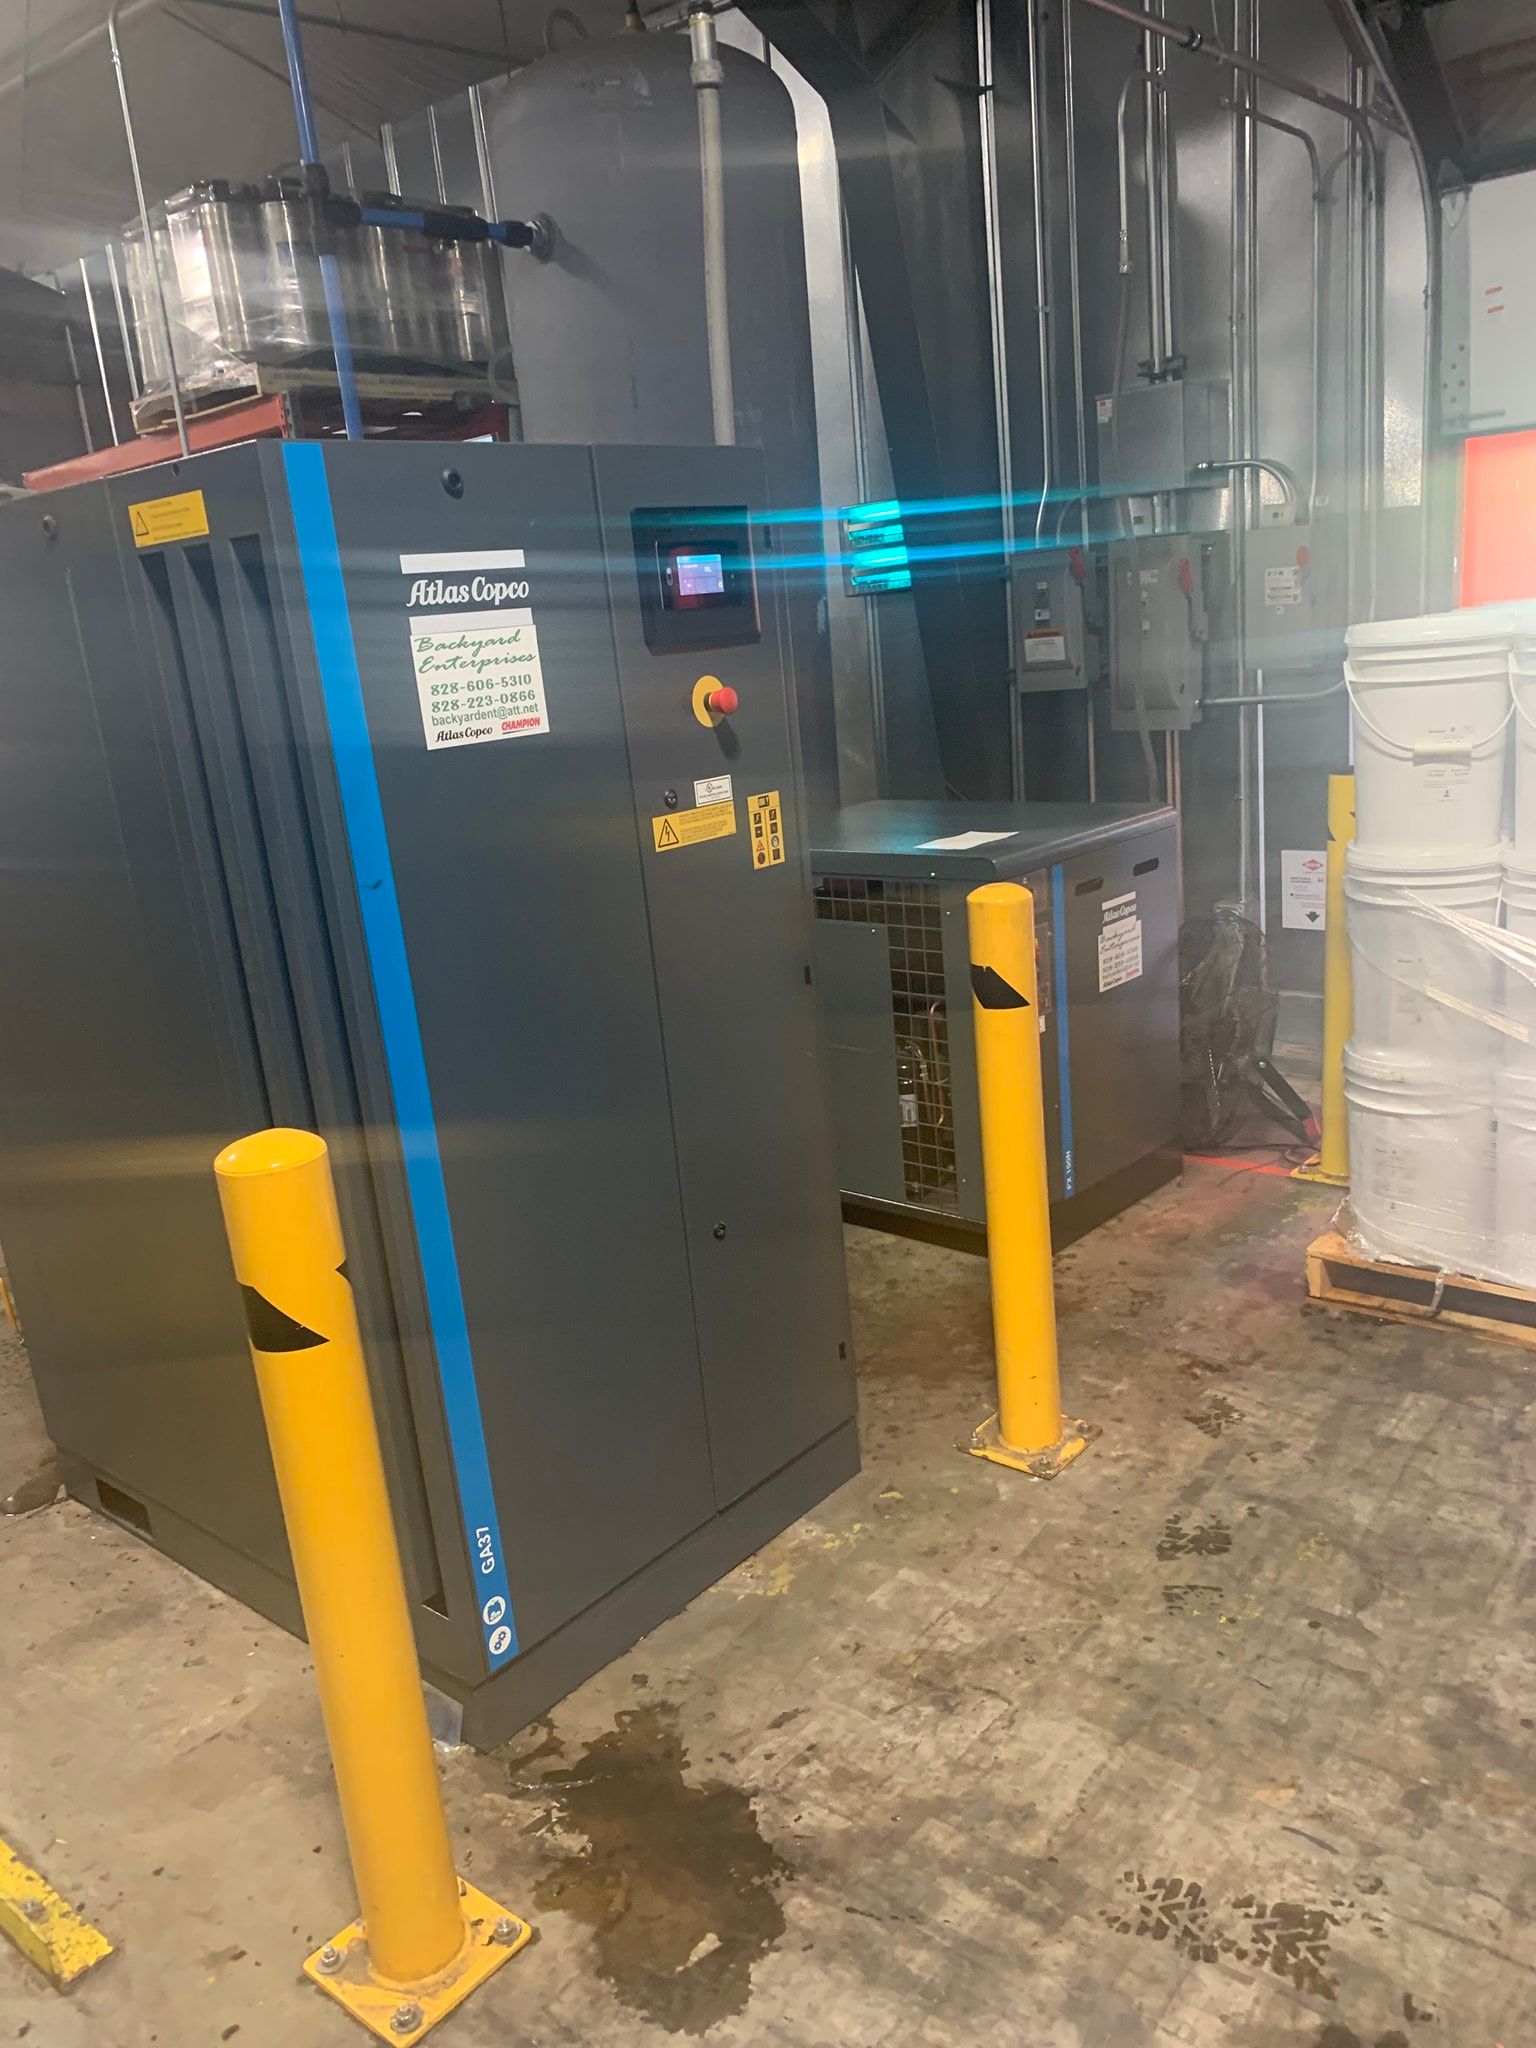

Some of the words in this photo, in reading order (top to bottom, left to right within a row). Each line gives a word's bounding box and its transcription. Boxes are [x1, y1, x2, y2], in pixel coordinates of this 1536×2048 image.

[406, 579, 469, 607] Atlas
[471, 576, 530, 606] Copco
[414, 629, 521, 657] Backyard
[418, 652, 537, 675] Enterprises
[430, 674, 532, 696] 828-606-5310
[431, 689, 536, 713] 828-223-0866
[431, 703, 539, 727] backyardent@att.net
[435, 727, 464, 743] Atlas
[464, 726, 493, 739] Copco
[501, 717, 541, 731] CHAMPION
[476, 1526, 495, 1574] GA37
